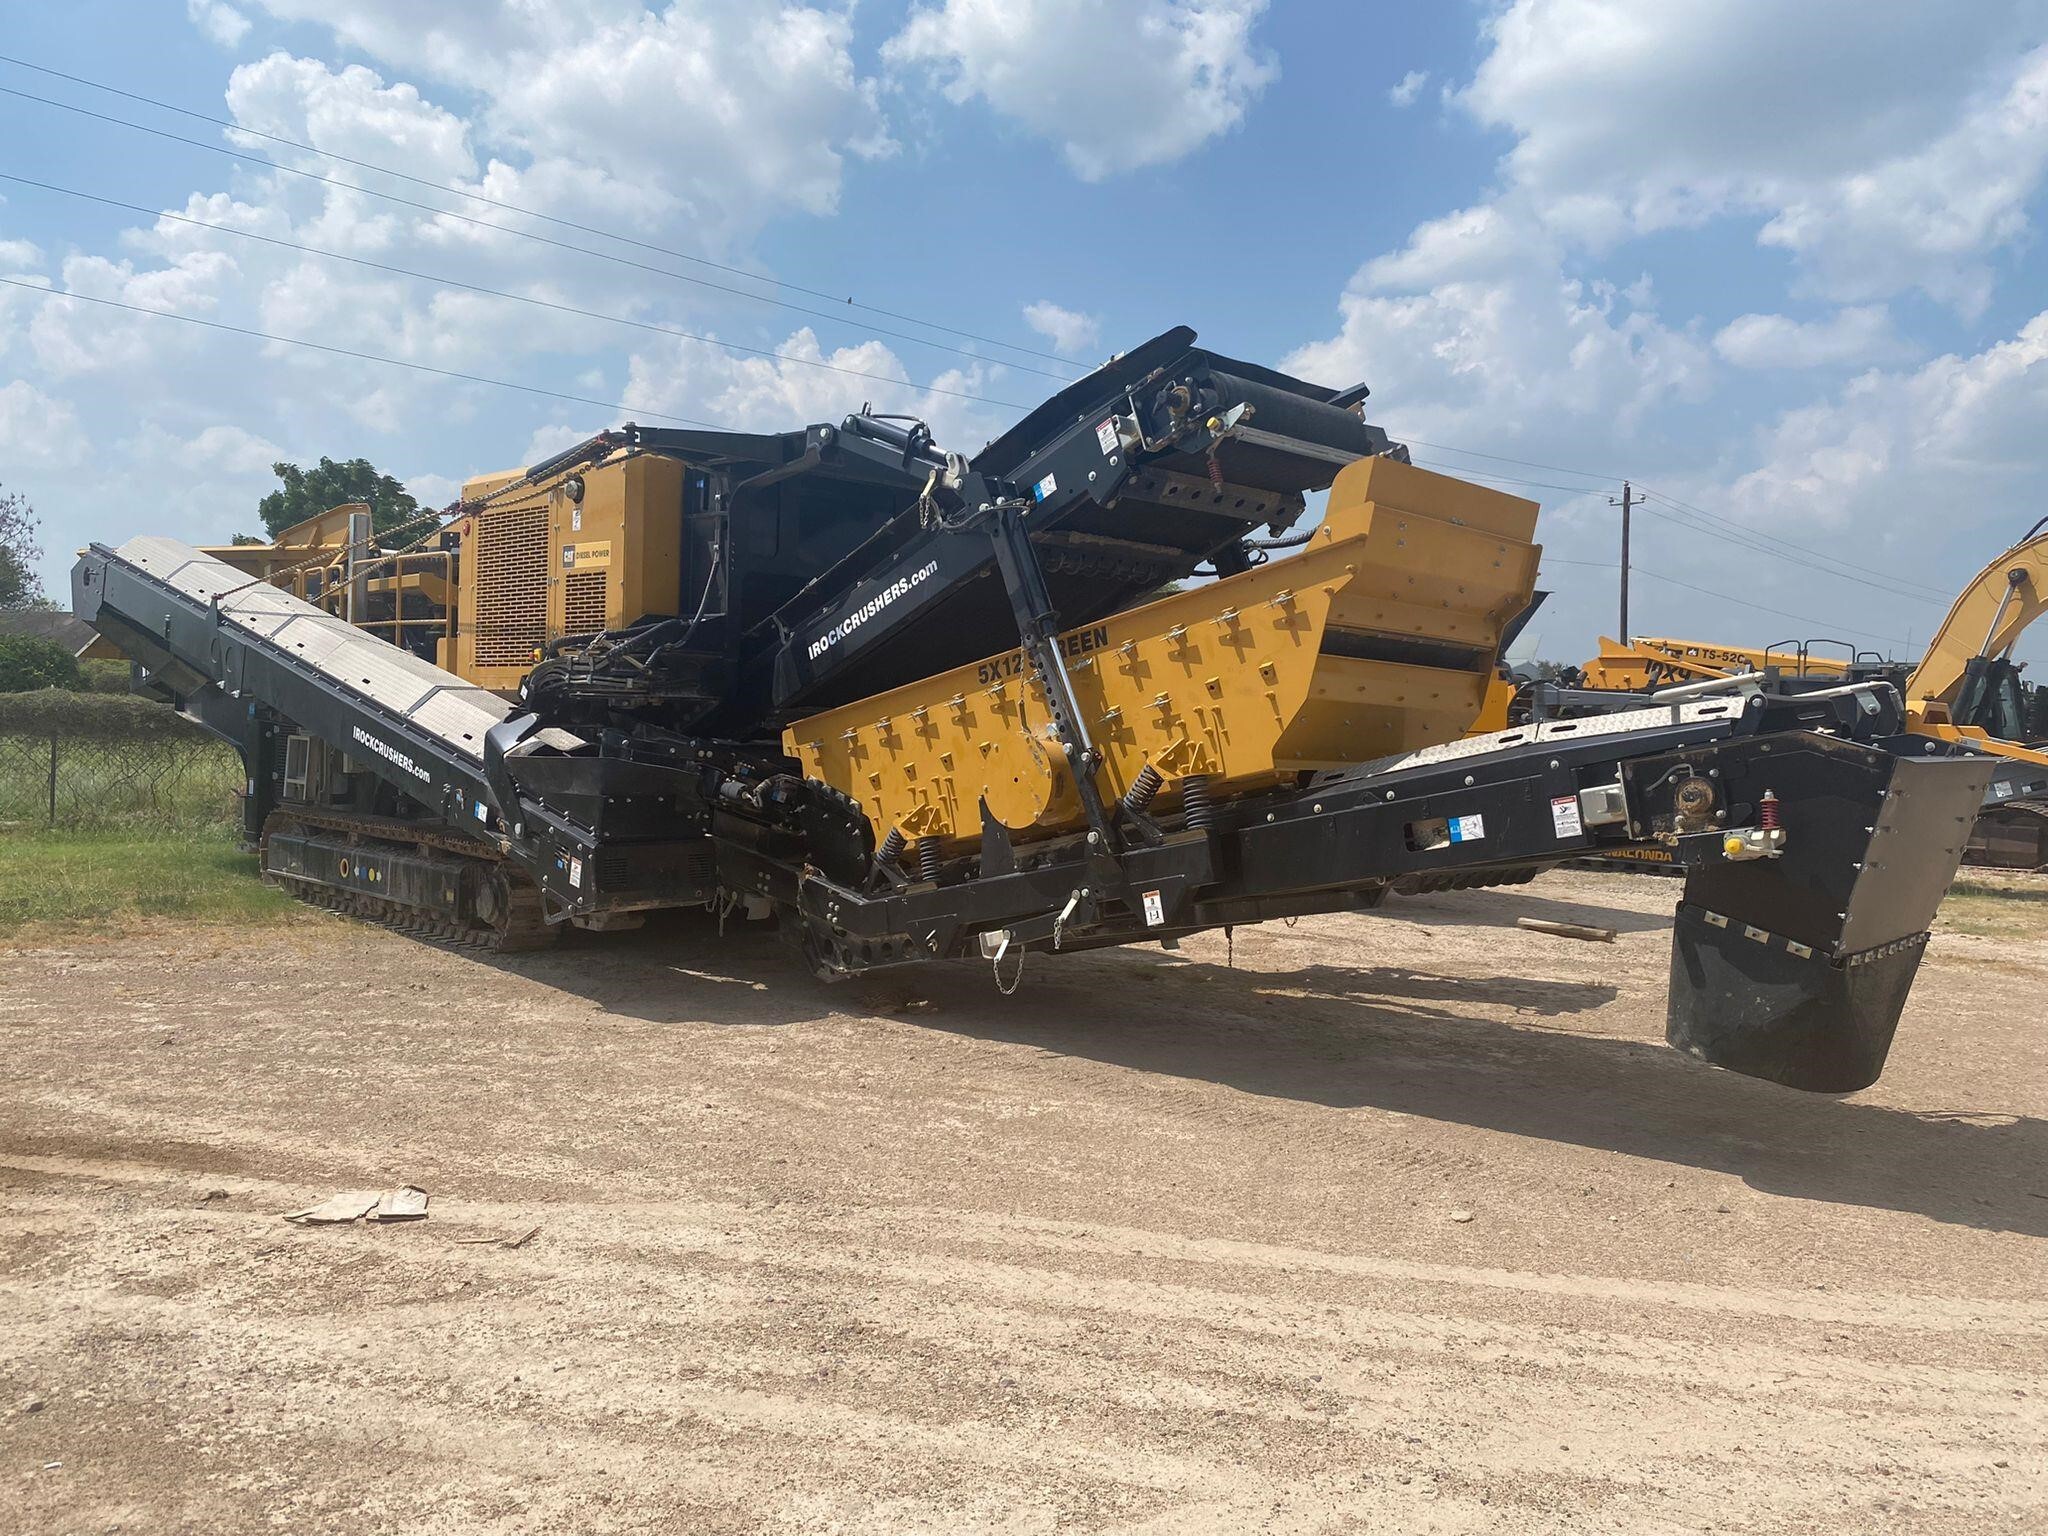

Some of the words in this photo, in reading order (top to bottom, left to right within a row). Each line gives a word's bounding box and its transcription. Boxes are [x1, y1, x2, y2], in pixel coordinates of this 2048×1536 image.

[576, 551, 591, 560] DIESEL
[592, 549, 610, 558] POWER
[807, 560, 939, 660] IROCKCRUSHERS.com
[978, 653, 1022, 685] 5X12
[1027, 625, 1109, 668] SREEN
[352, 725, 431, 784] IROCKCRUSHERS.com
